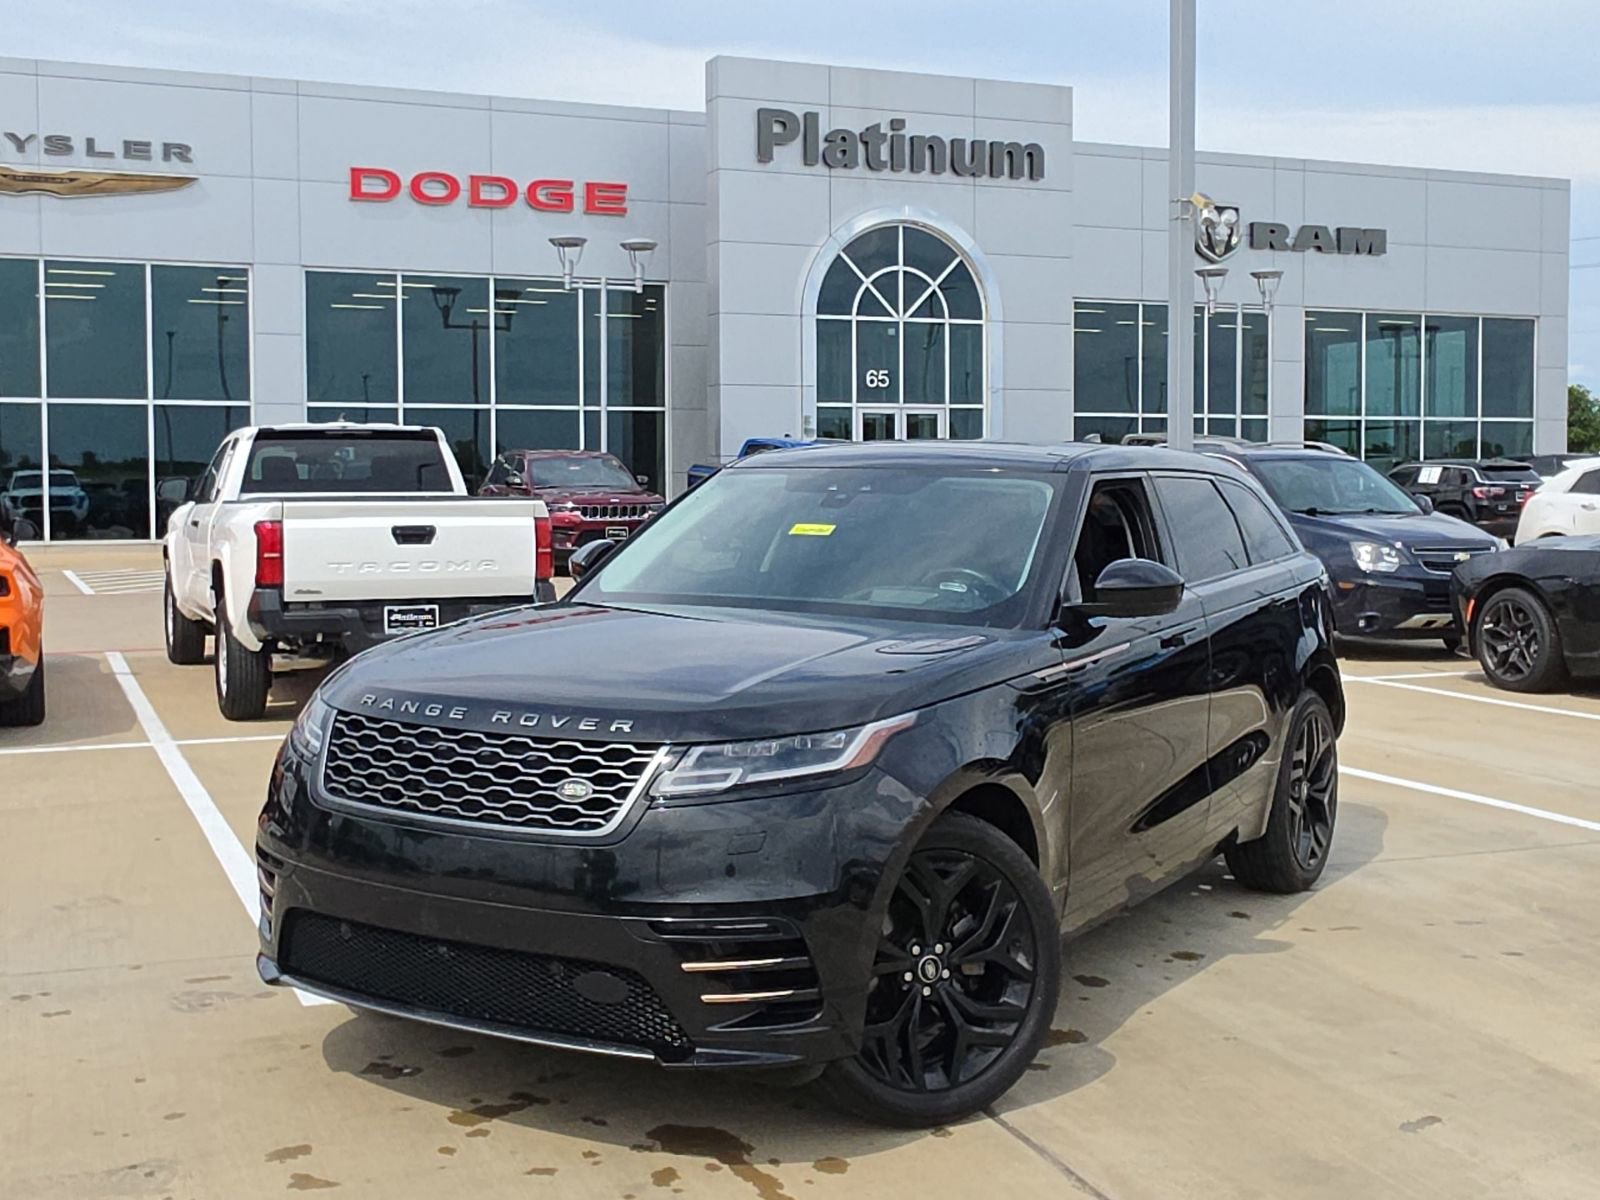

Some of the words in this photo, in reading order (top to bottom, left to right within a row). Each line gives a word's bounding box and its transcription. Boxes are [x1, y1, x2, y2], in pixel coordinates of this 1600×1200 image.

[3, 131, 194, 163] YSLER
[757, 107, 1046, 181] Platinum
[349, 167, 628, 217] DODGE
[1249, 221, 1388, 256] RAM
[865, 369, 890, 388] 65
[327, 559, 500, 575] TACOMA
[360, 693, 468, 720] RANGE
[491, 710, 635, 733] ROVER
